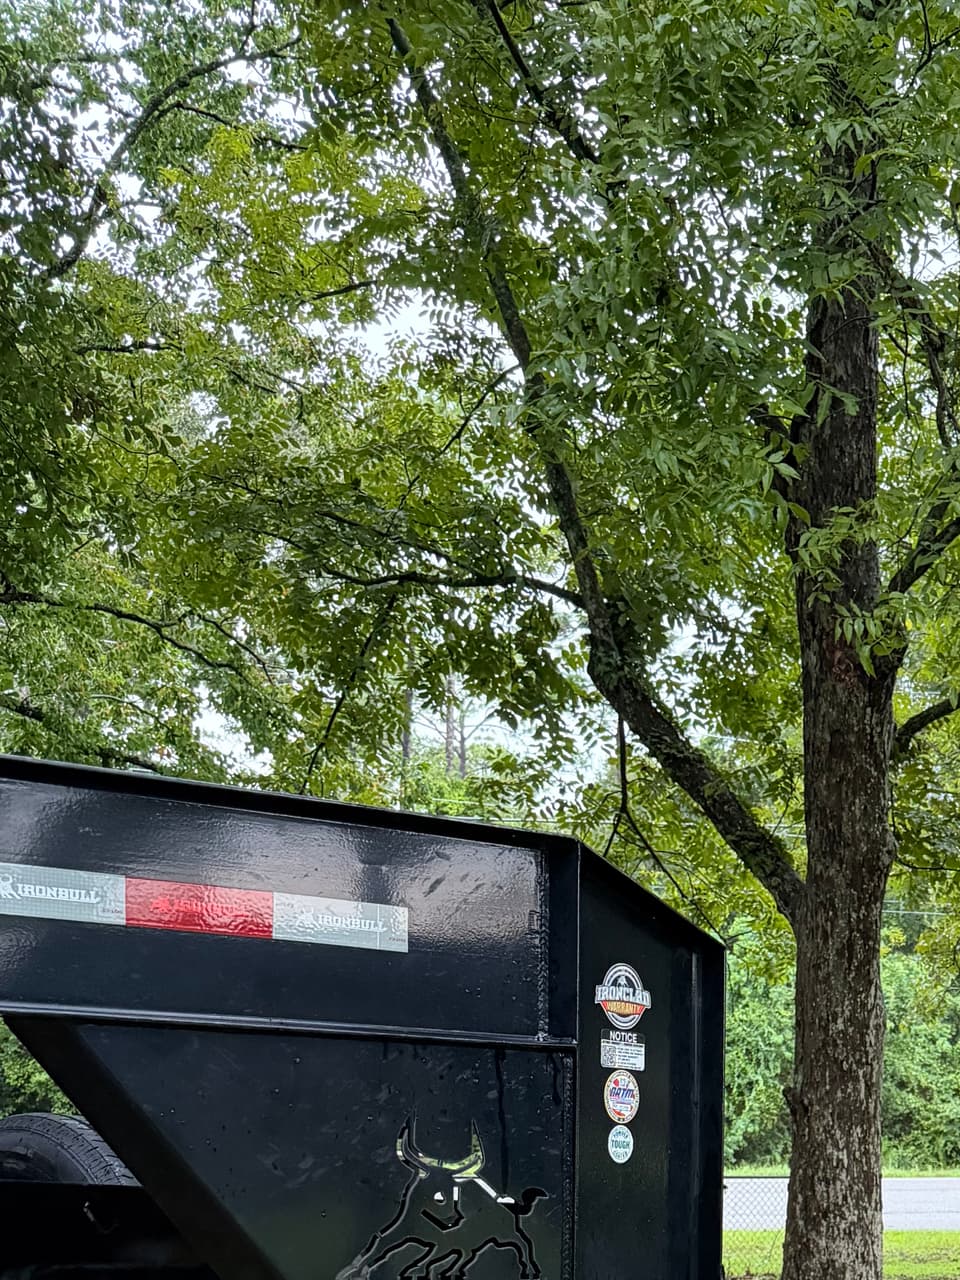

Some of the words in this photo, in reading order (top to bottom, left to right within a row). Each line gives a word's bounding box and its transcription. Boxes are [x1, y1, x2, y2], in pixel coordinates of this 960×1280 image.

[16, 883, 100, 904] IRONBULL
[317, 912, 388, 932] IRONBULL
[597, 986, 650, 1006] IRONCLAD
[609, 1030, 638, 1043] NOTICE
[611, 1139, 631, 1150] TOUGH
